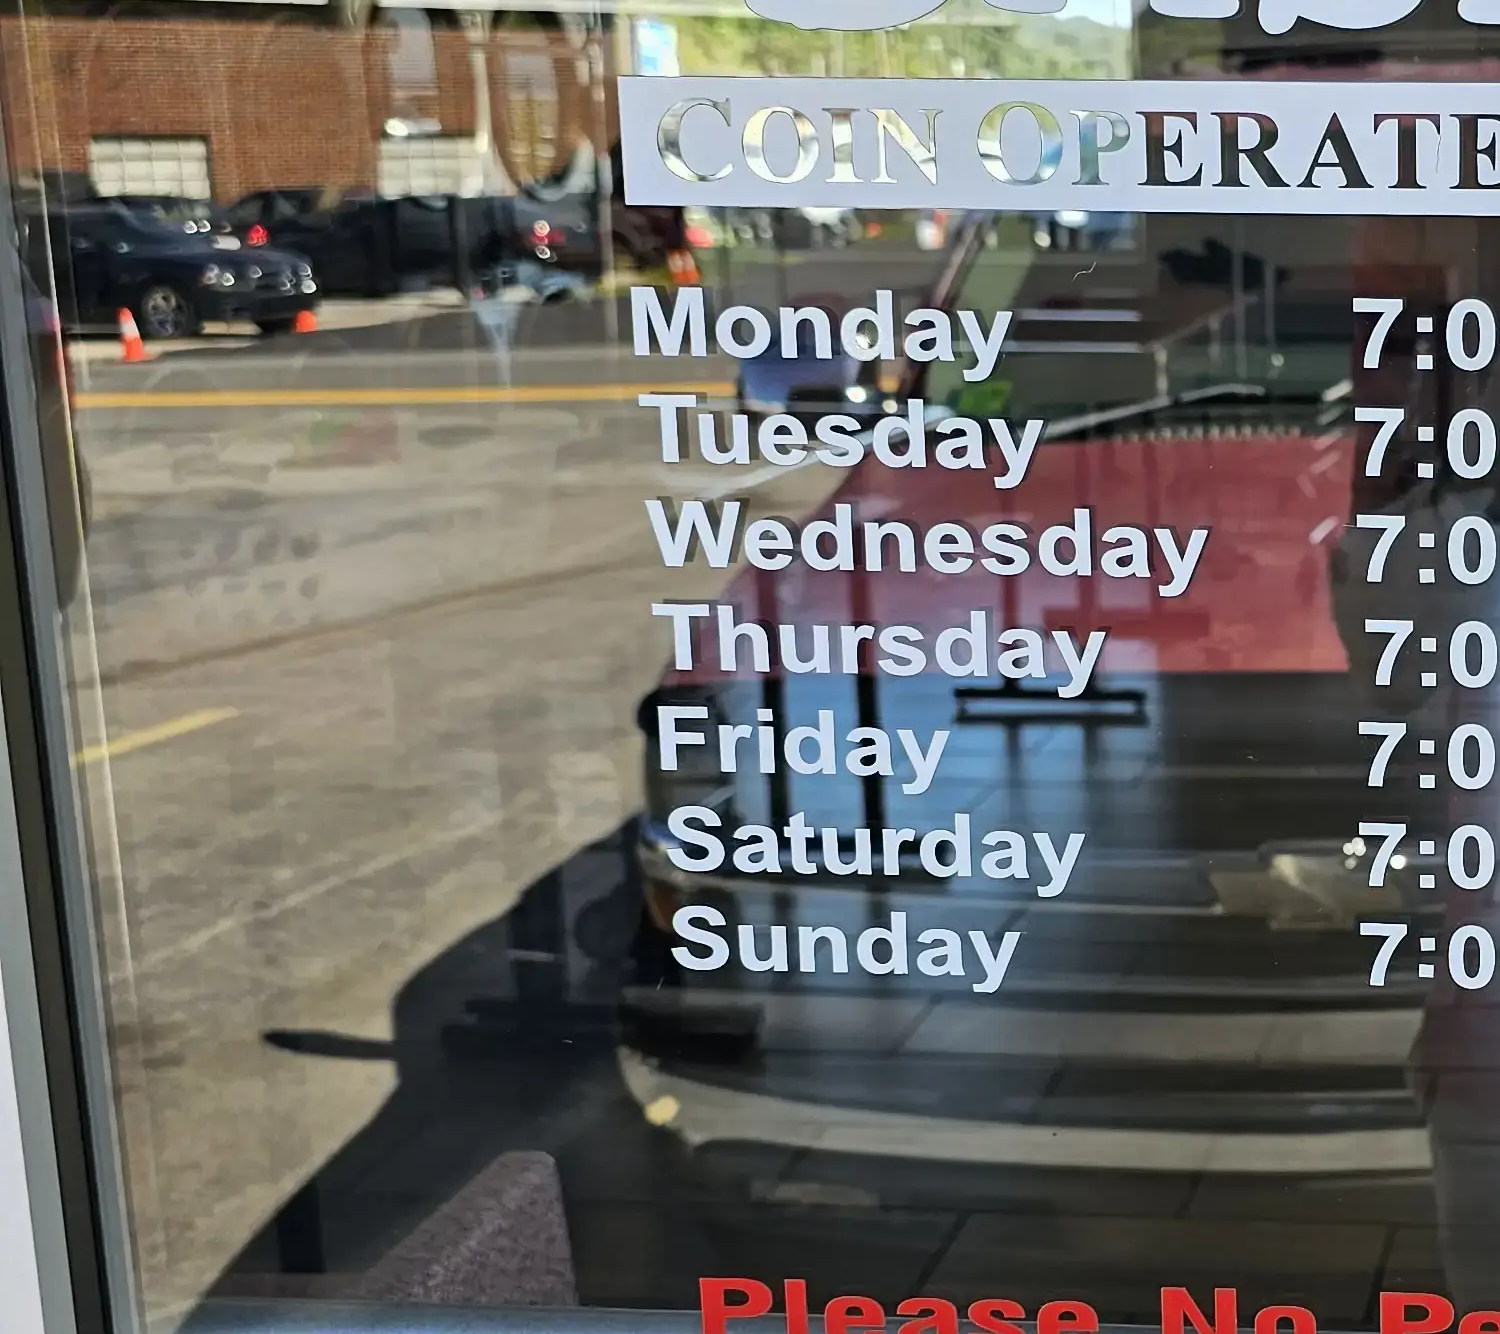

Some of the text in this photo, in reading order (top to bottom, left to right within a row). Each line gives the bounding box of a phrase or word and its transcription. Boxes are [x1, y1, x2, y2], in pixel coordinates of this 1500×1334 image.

[656, 97, 944, 186] COIN
[630, 286, 1013, 382] Monday
[638, 393, 1044, 489] Tuesday
[644, 499, 1208, 598] Wednesday
[651, 603, 1107, 699] Thursday
[657, 705, 951, 795] Friday
[666, 805, 1086, 898] Saturday
[671, 905, 1021, 994] Sunday
